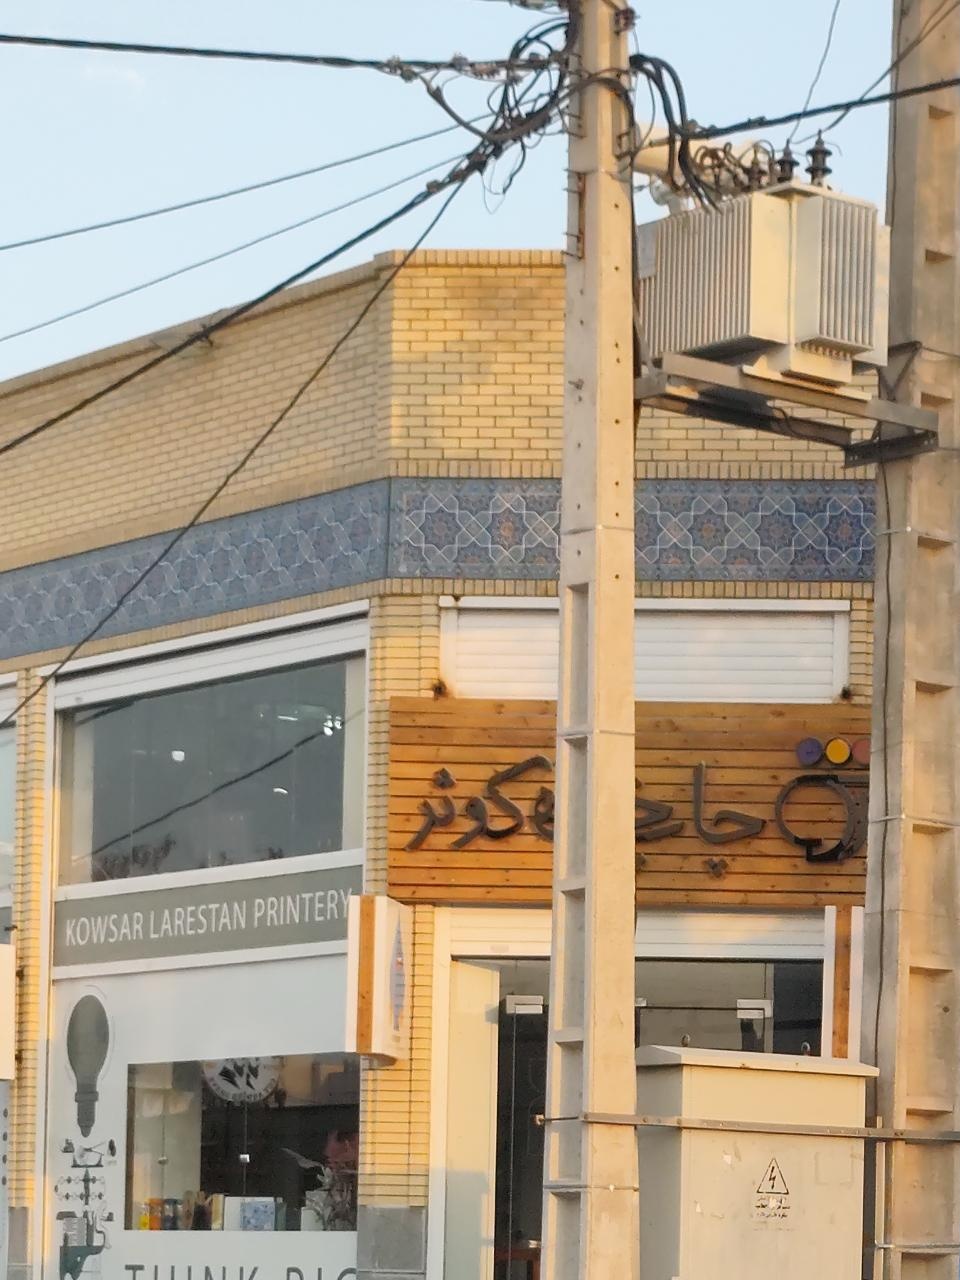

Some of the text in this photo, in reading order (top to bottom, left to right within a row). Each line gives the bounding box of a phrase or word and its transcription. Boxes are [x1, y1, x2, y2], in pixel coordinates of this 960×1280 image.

[66, 888, 353, 947] KOWSAR LARESTAN PRINTERY
